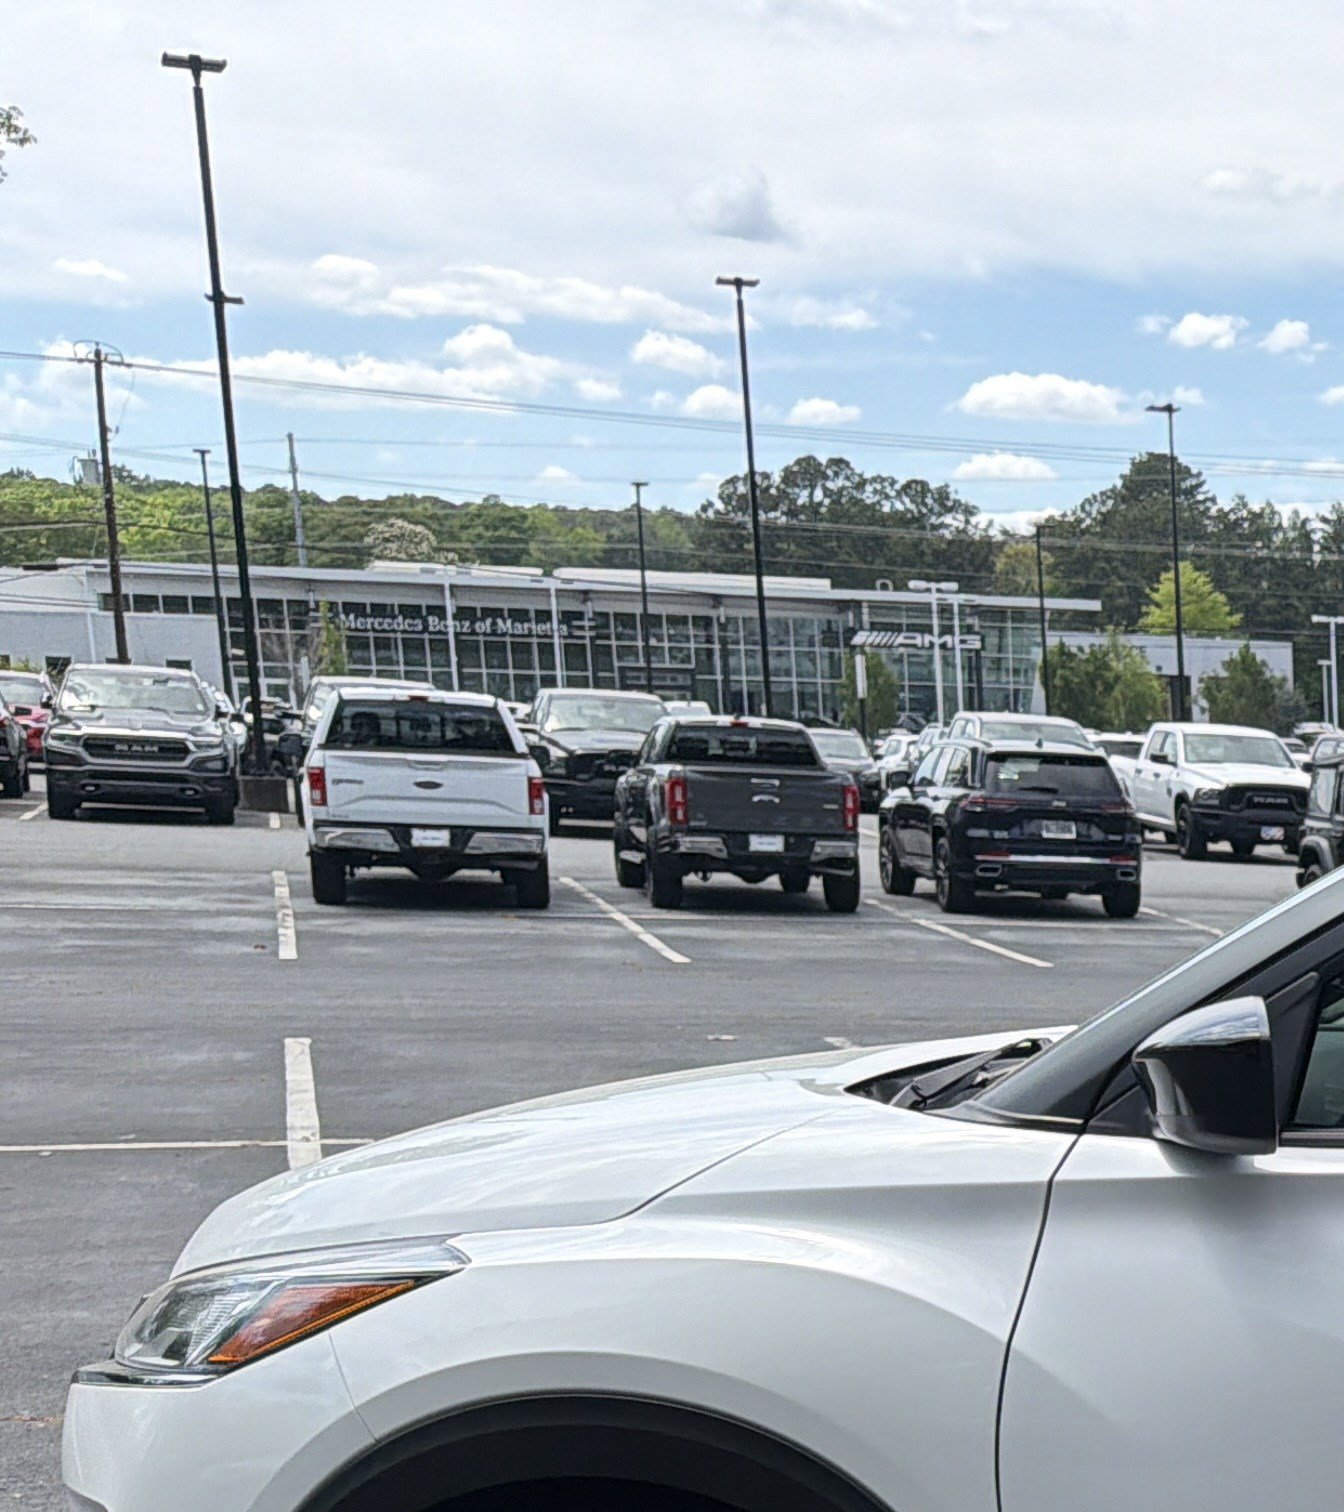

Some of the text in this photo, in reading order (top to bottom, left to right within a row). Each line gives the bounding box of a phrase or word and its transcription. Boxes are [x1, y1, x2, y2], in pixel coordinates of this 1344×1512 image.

[475, 617, 493, 634] of
[496, 618, 569, 636] Marieta
[893, 631, 982, 649] AMG
